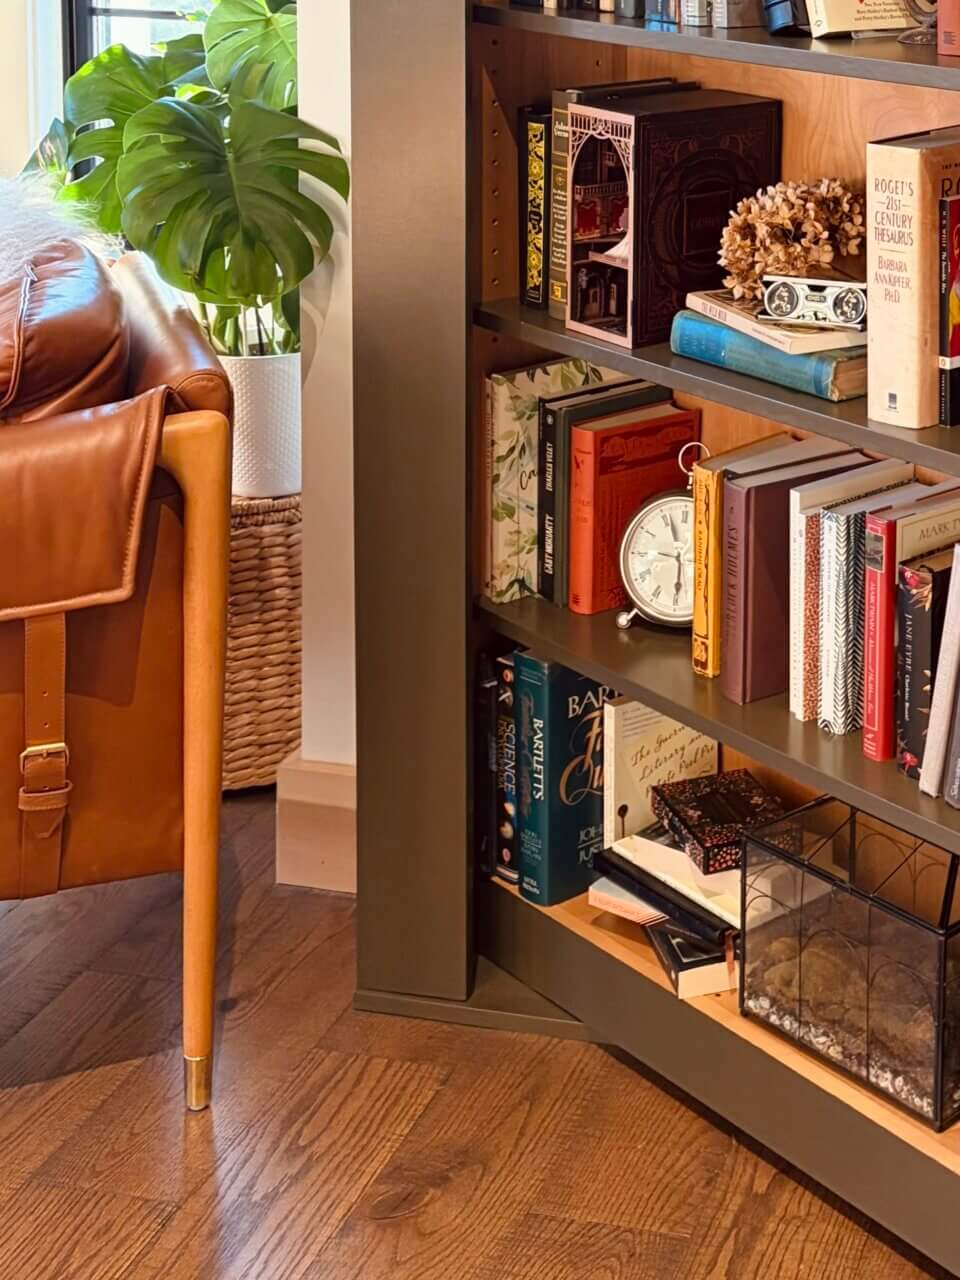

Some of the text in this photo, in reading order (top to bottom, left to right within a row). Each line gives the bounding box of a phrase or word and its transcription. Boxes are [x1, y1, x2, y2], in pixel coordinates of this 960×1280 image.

[874, 177, 915, 197] ROGET'S
[885, 195, 902, 211] 21ST
[874, 210, 913, 230] CENTURY
[873, 226, 915, 247] THESAURUS
[877, 255, 908, 273] BARBARA
[874, 271, 889, 285] ANN
[545, 462, 553, 492] CHARLES
[919, 521, 950, 540] MARK
[544, 514, 554, 575] LAST MORIARTY
[726, 526, 738, 578] HOLMES
[904, 613, 913, 640] JANE
[904, 644, 913, 672] EYRE
[504, 721, 516, 795] SCIENCE
[631, 744, 651, 768] The
[639, 745, 687, 782] Literary
